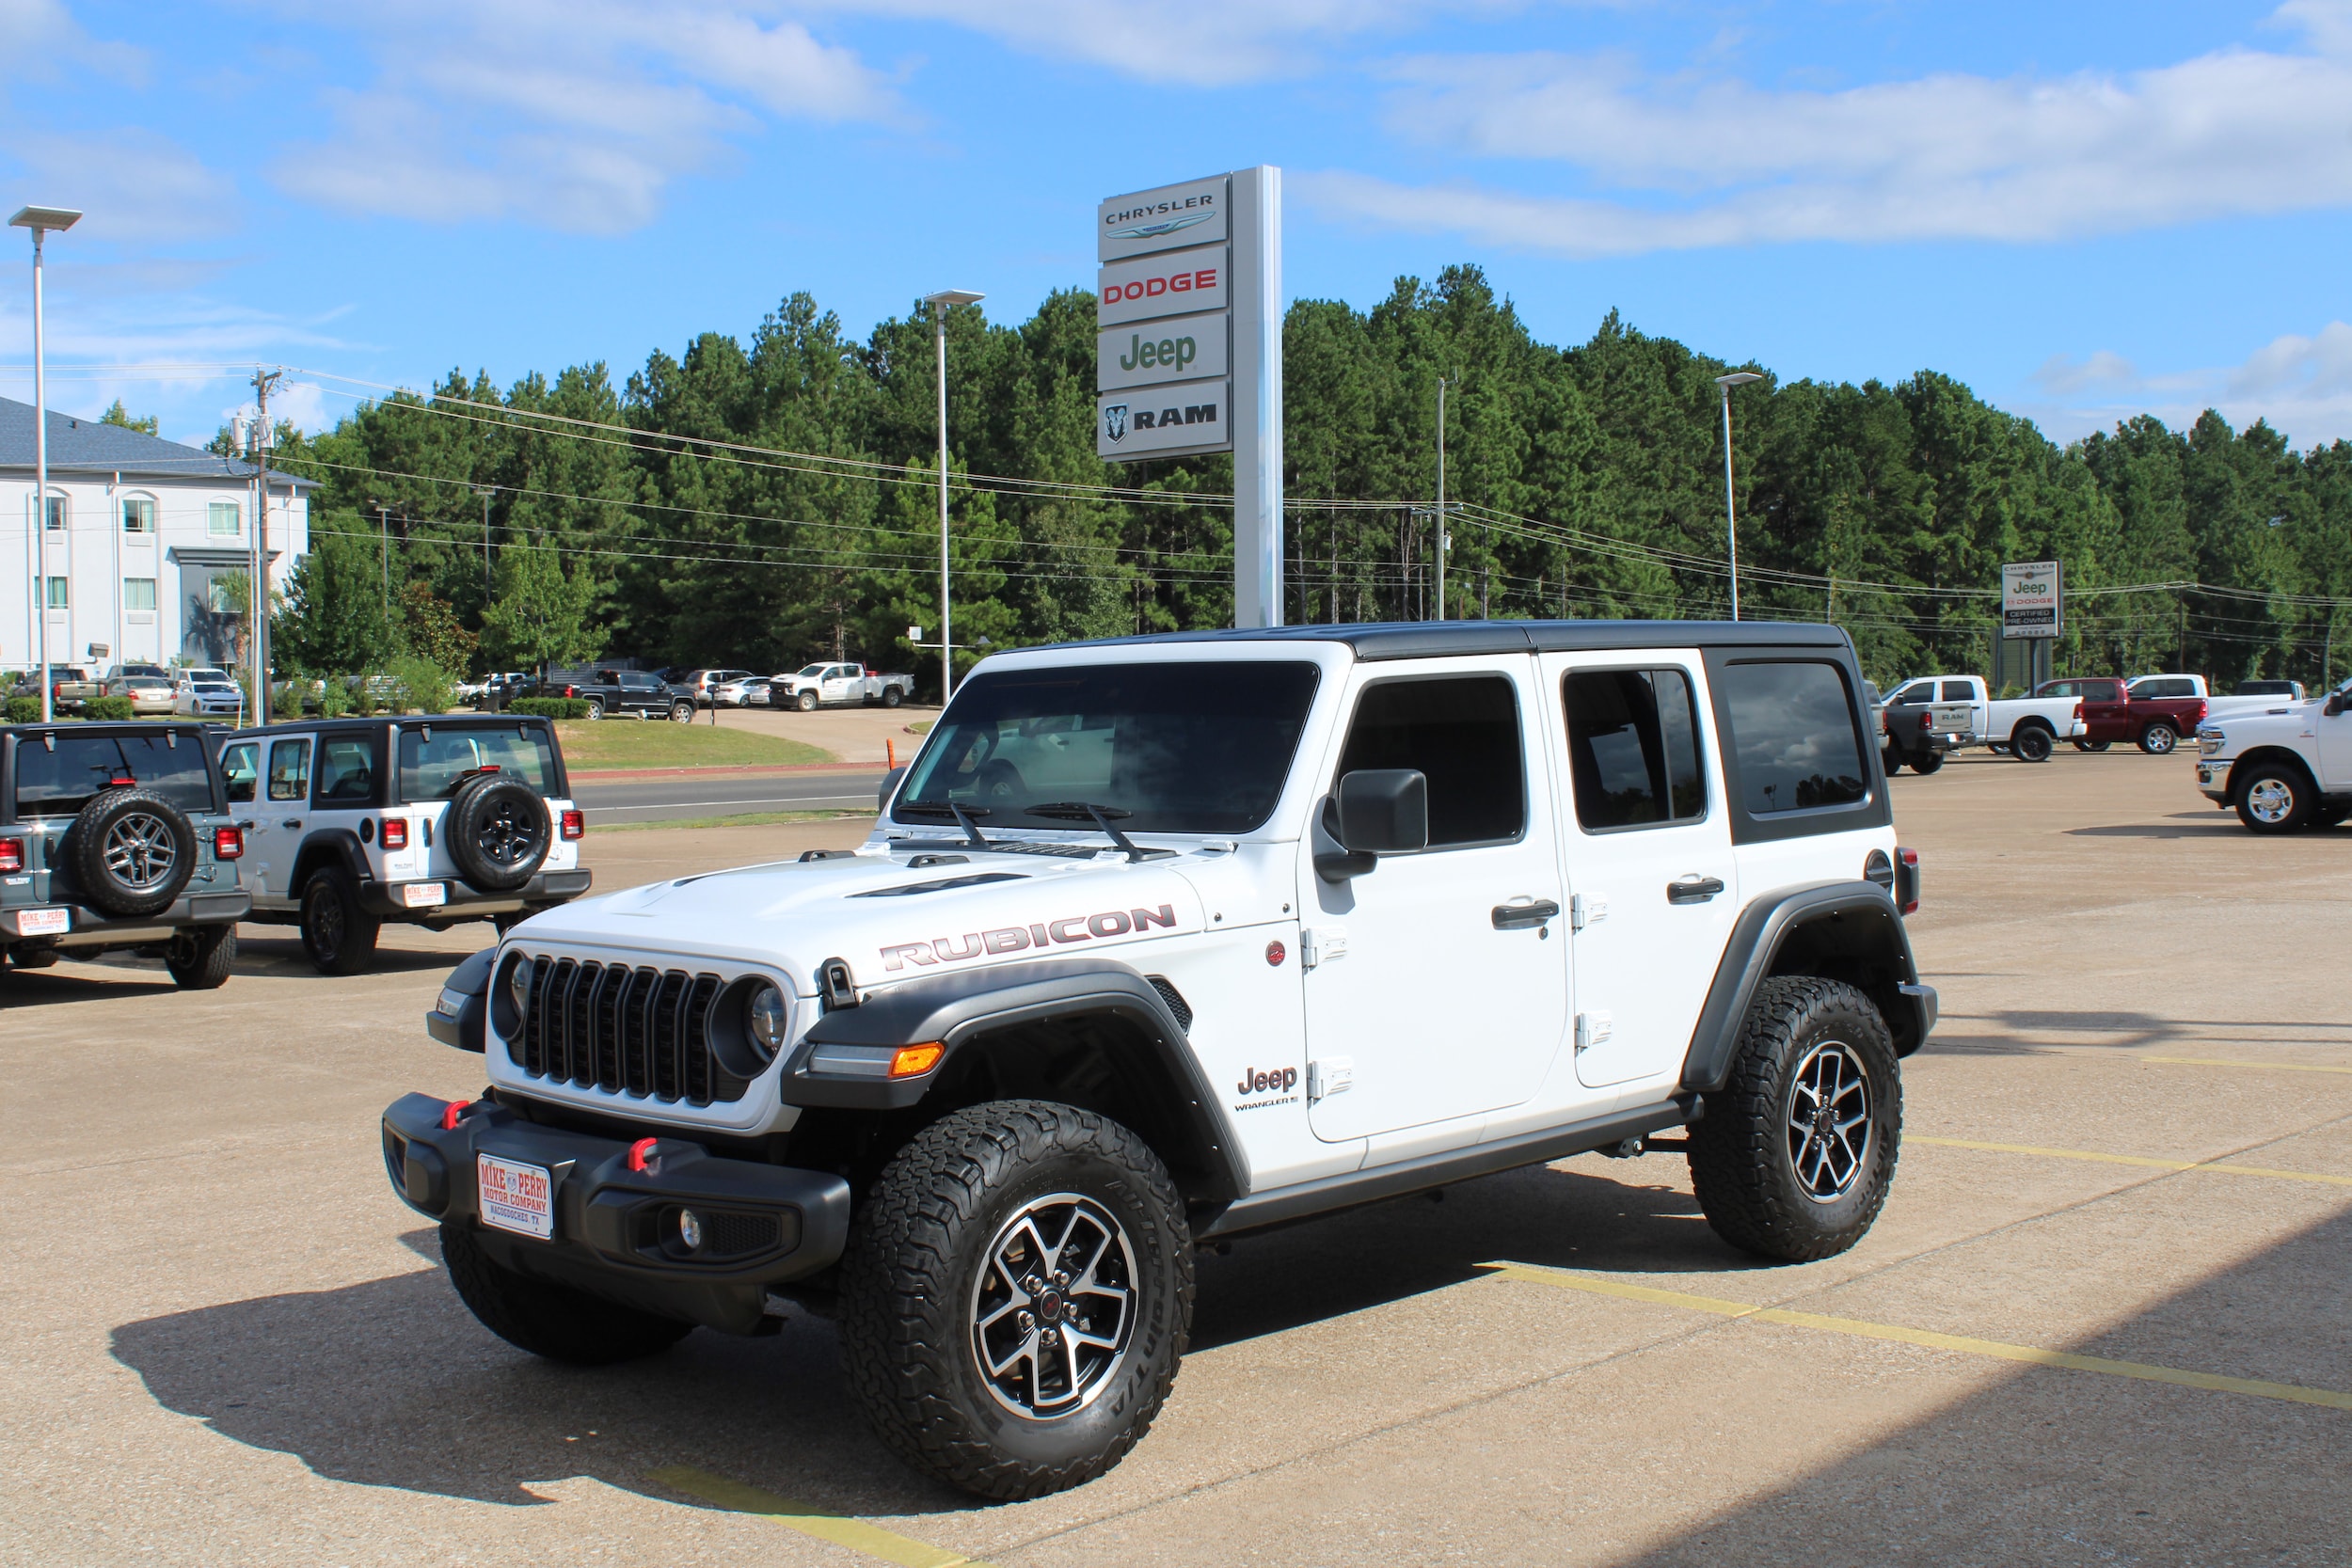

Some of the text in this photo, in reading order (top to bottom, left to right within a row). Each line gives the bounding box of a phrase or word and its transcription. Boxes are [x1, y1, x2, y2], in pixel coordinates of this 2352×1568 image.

[1105, 195, 1213, 225] CHRYSLER
[1104, 269, 1216, 305] DODGE
[1120, 334, 1196, 372] Jeep
[1134, 404, 1216, 431] RAM
[2013, 581, 2046, 595] Jeep
[2010, 610, 2050, 618] CERTIFIED
[406, 886, 421, 895] MIKE
[21, 912, 39, 922] MIKE
[879, 904, 1177, 972] RUBICON
[1237, 1067, 1297, 1096] Jeep
[1234, 1098, 1289, 1112] WRANGLER
[481, 1164, 548, 1200] MIKE PERRY
[484, 1187, 547, 1212] MOTOR COMPANY
[532, 1215, 540, 1226] TX
